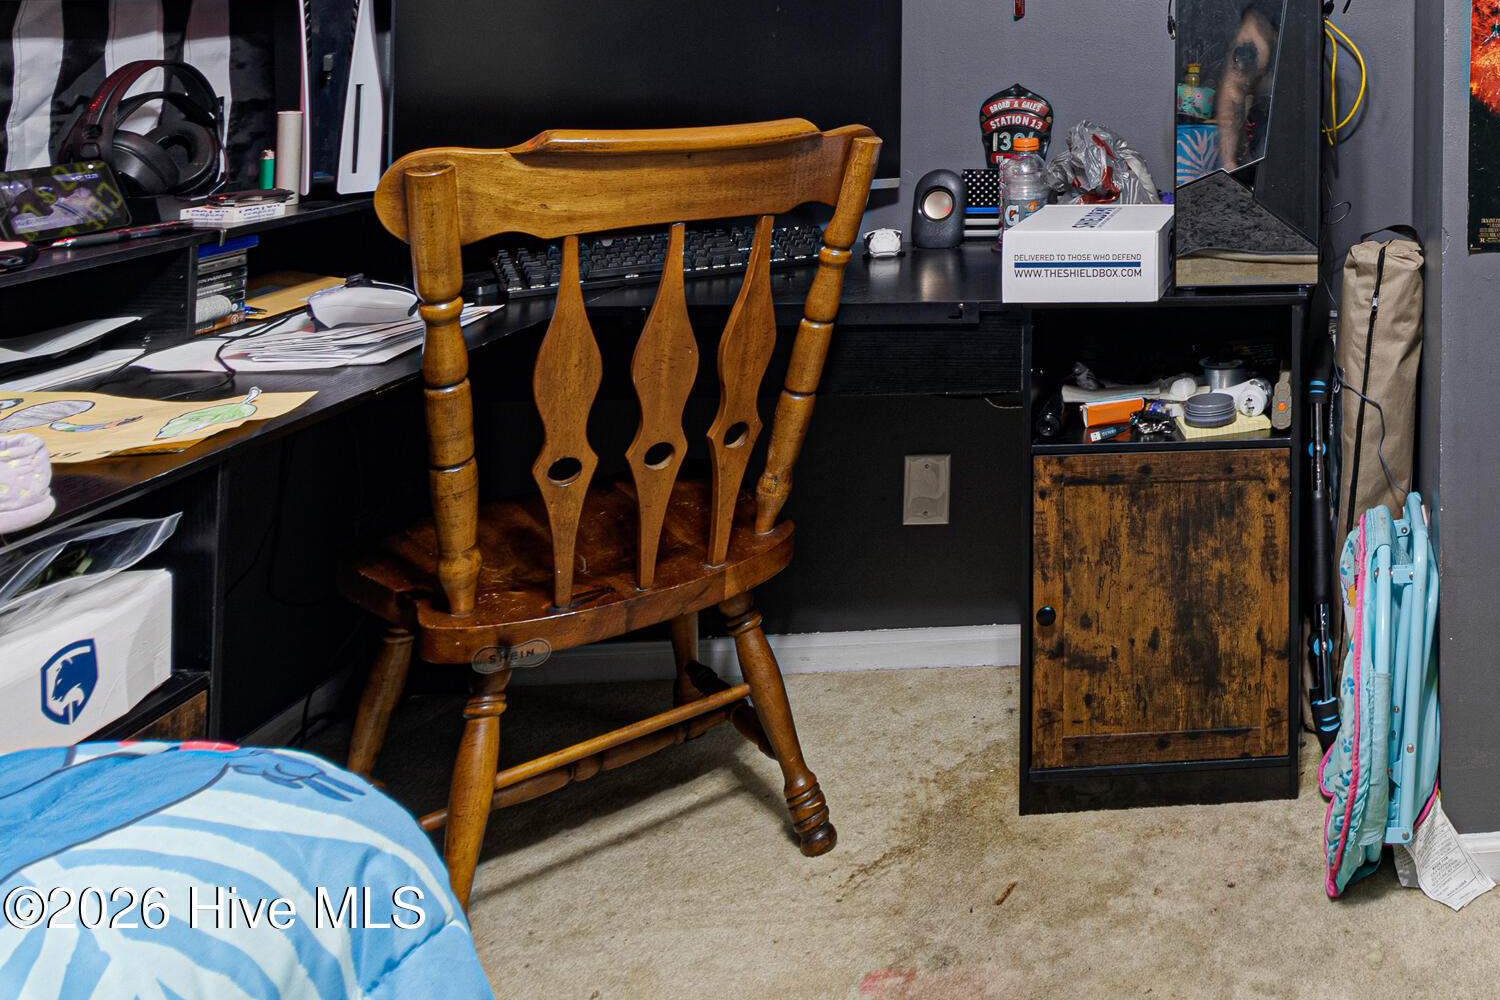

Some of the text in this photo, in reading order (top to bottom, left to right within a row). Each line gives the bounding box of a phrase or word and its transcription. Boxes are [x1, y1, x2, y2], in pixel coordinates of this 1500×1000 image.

[989, 101, 1010, 114] BROAD
[1022, 101, 1042, 112] GALES
[990, 116, 1042, 130] STATION 13
[1005, 205, 1020, 226] G
[1014, 254, 1055, 262] DELIVERED
[1014, 268, 1142, 278] WWW.THESHIELDBOX.COM
